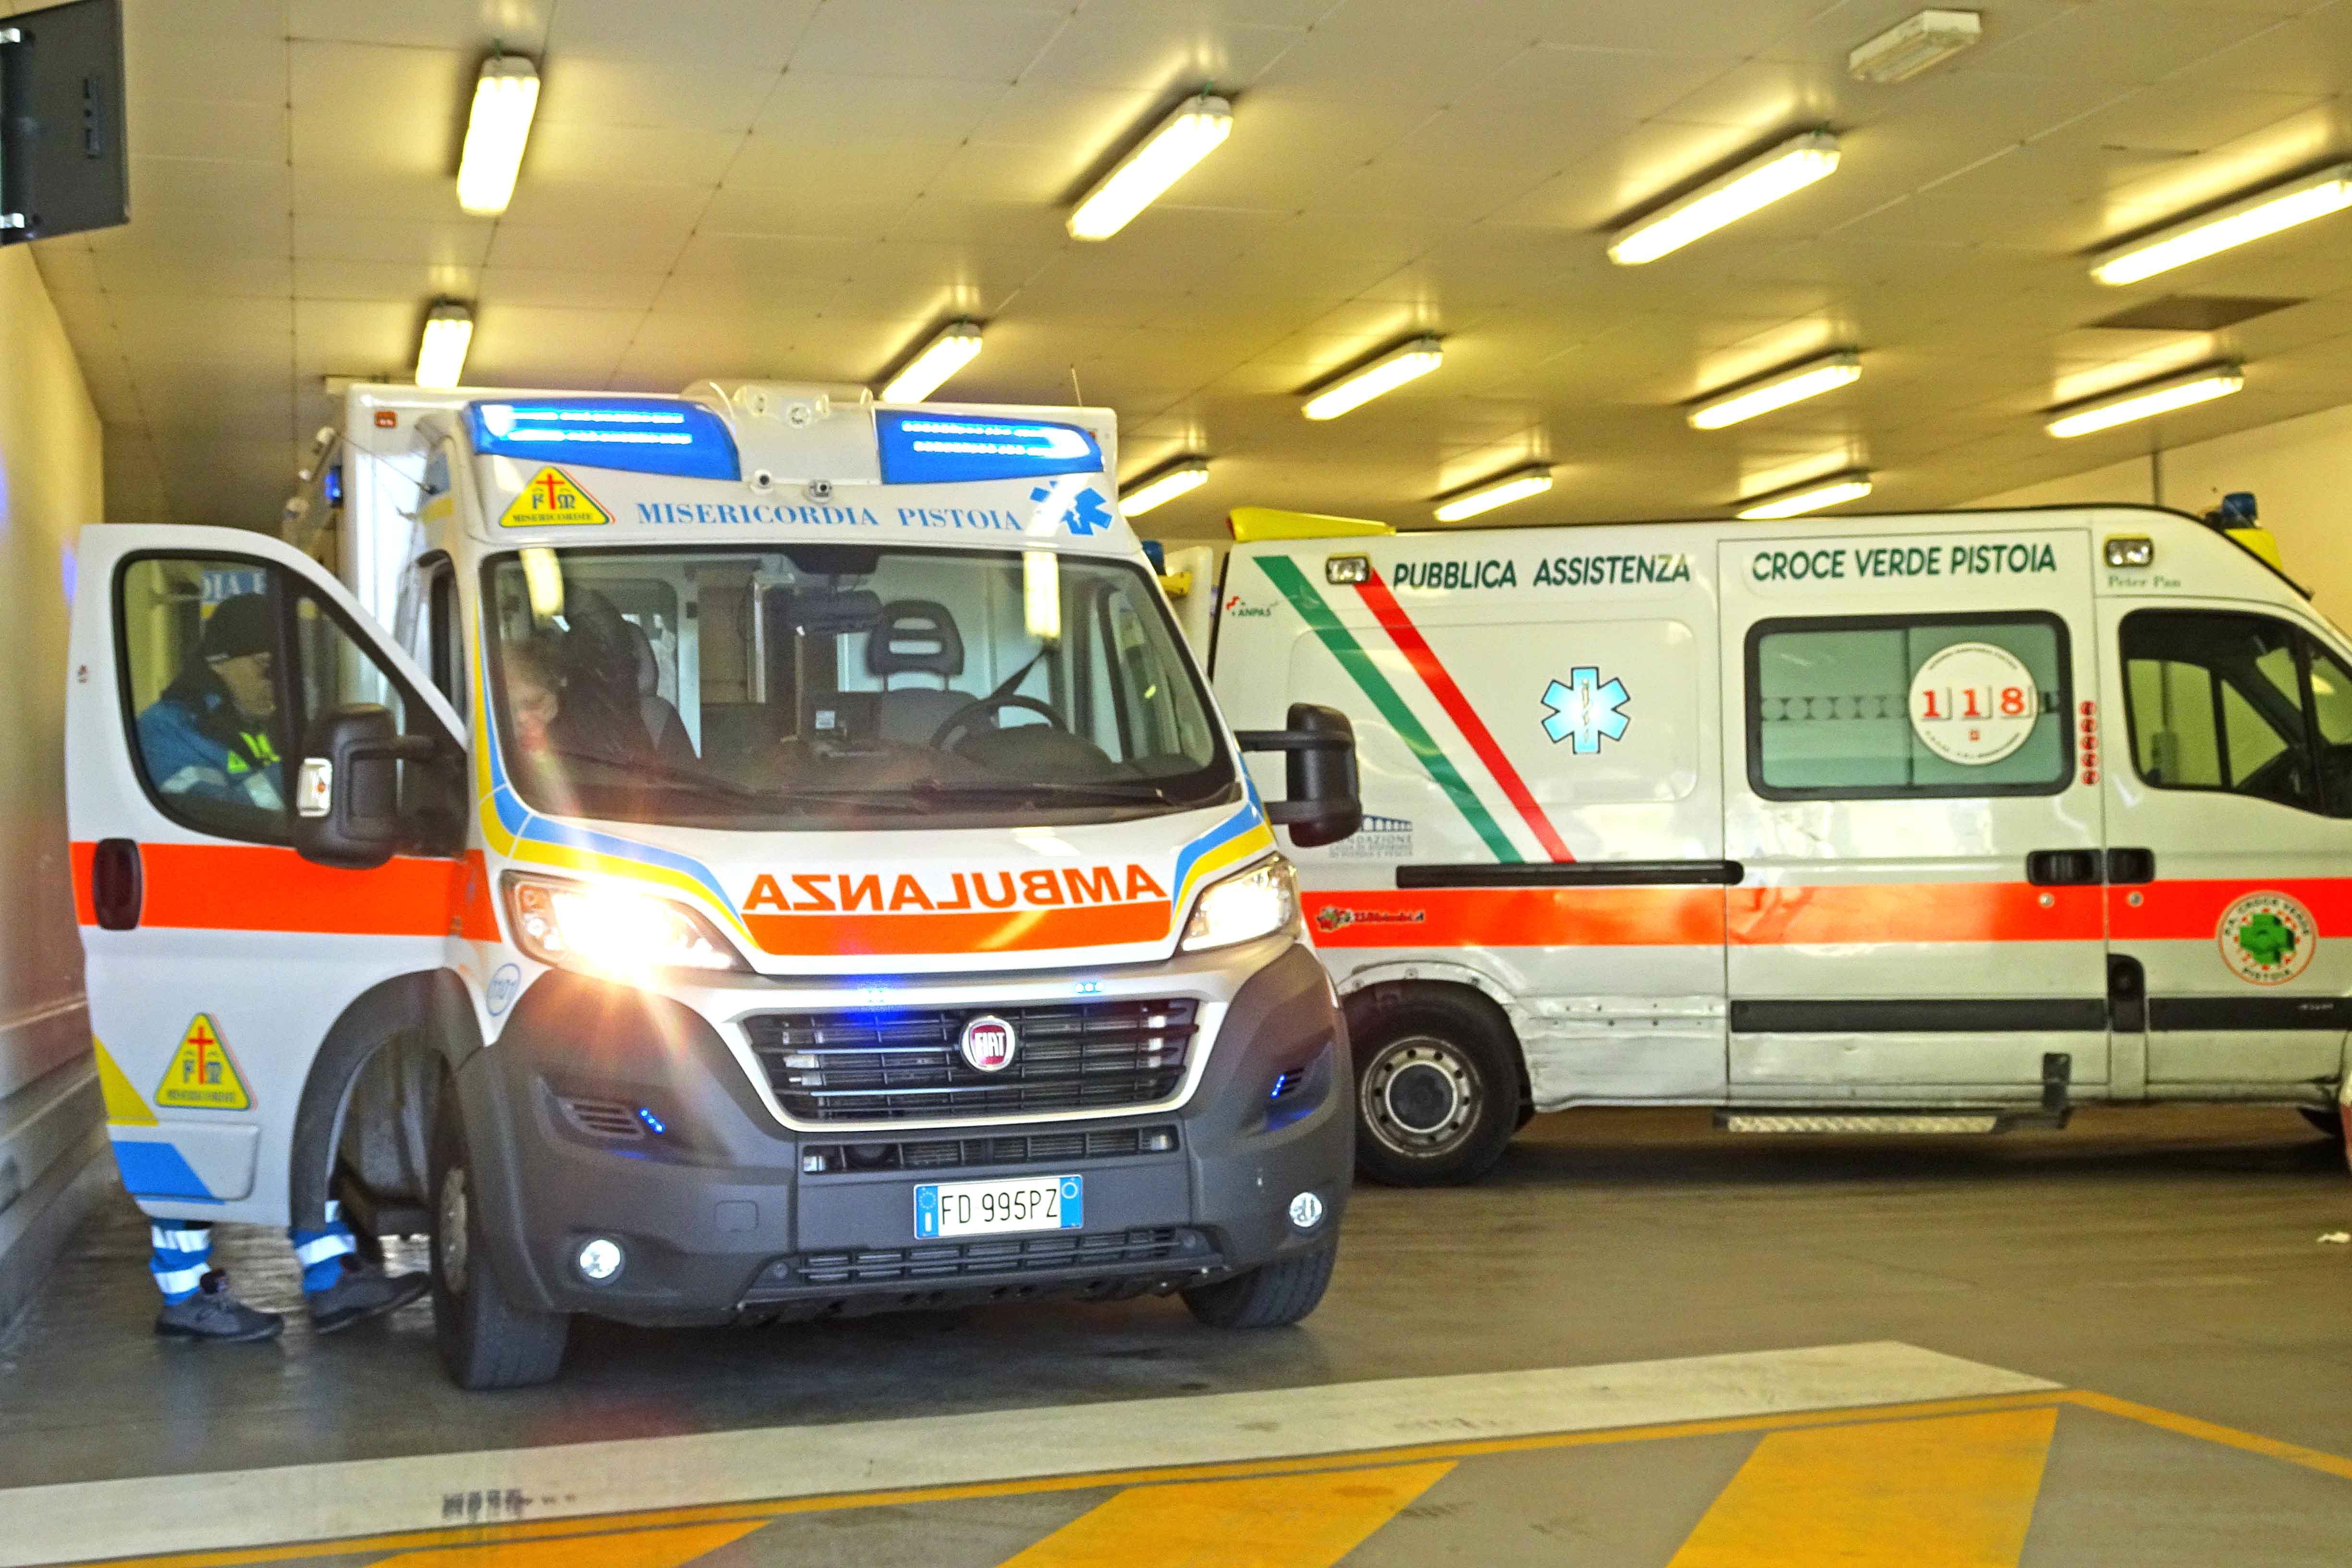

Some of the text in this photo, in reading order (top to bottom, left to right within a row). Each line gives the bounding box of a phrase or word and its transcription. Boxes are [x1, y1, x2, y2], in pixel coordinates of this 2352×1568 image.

[637, 502, 1022, 530] MISERICORDIA PISTOIA
[1393, 555, 1690, 588] PUBBLICA ASSISTENZA
[1752, 544, 2056, 581] CROCE VERDE PISTOIA
[975, 1032, 1005, 1057] FIAT
[942, 1188, 1058, 1225] FD 995PZ
